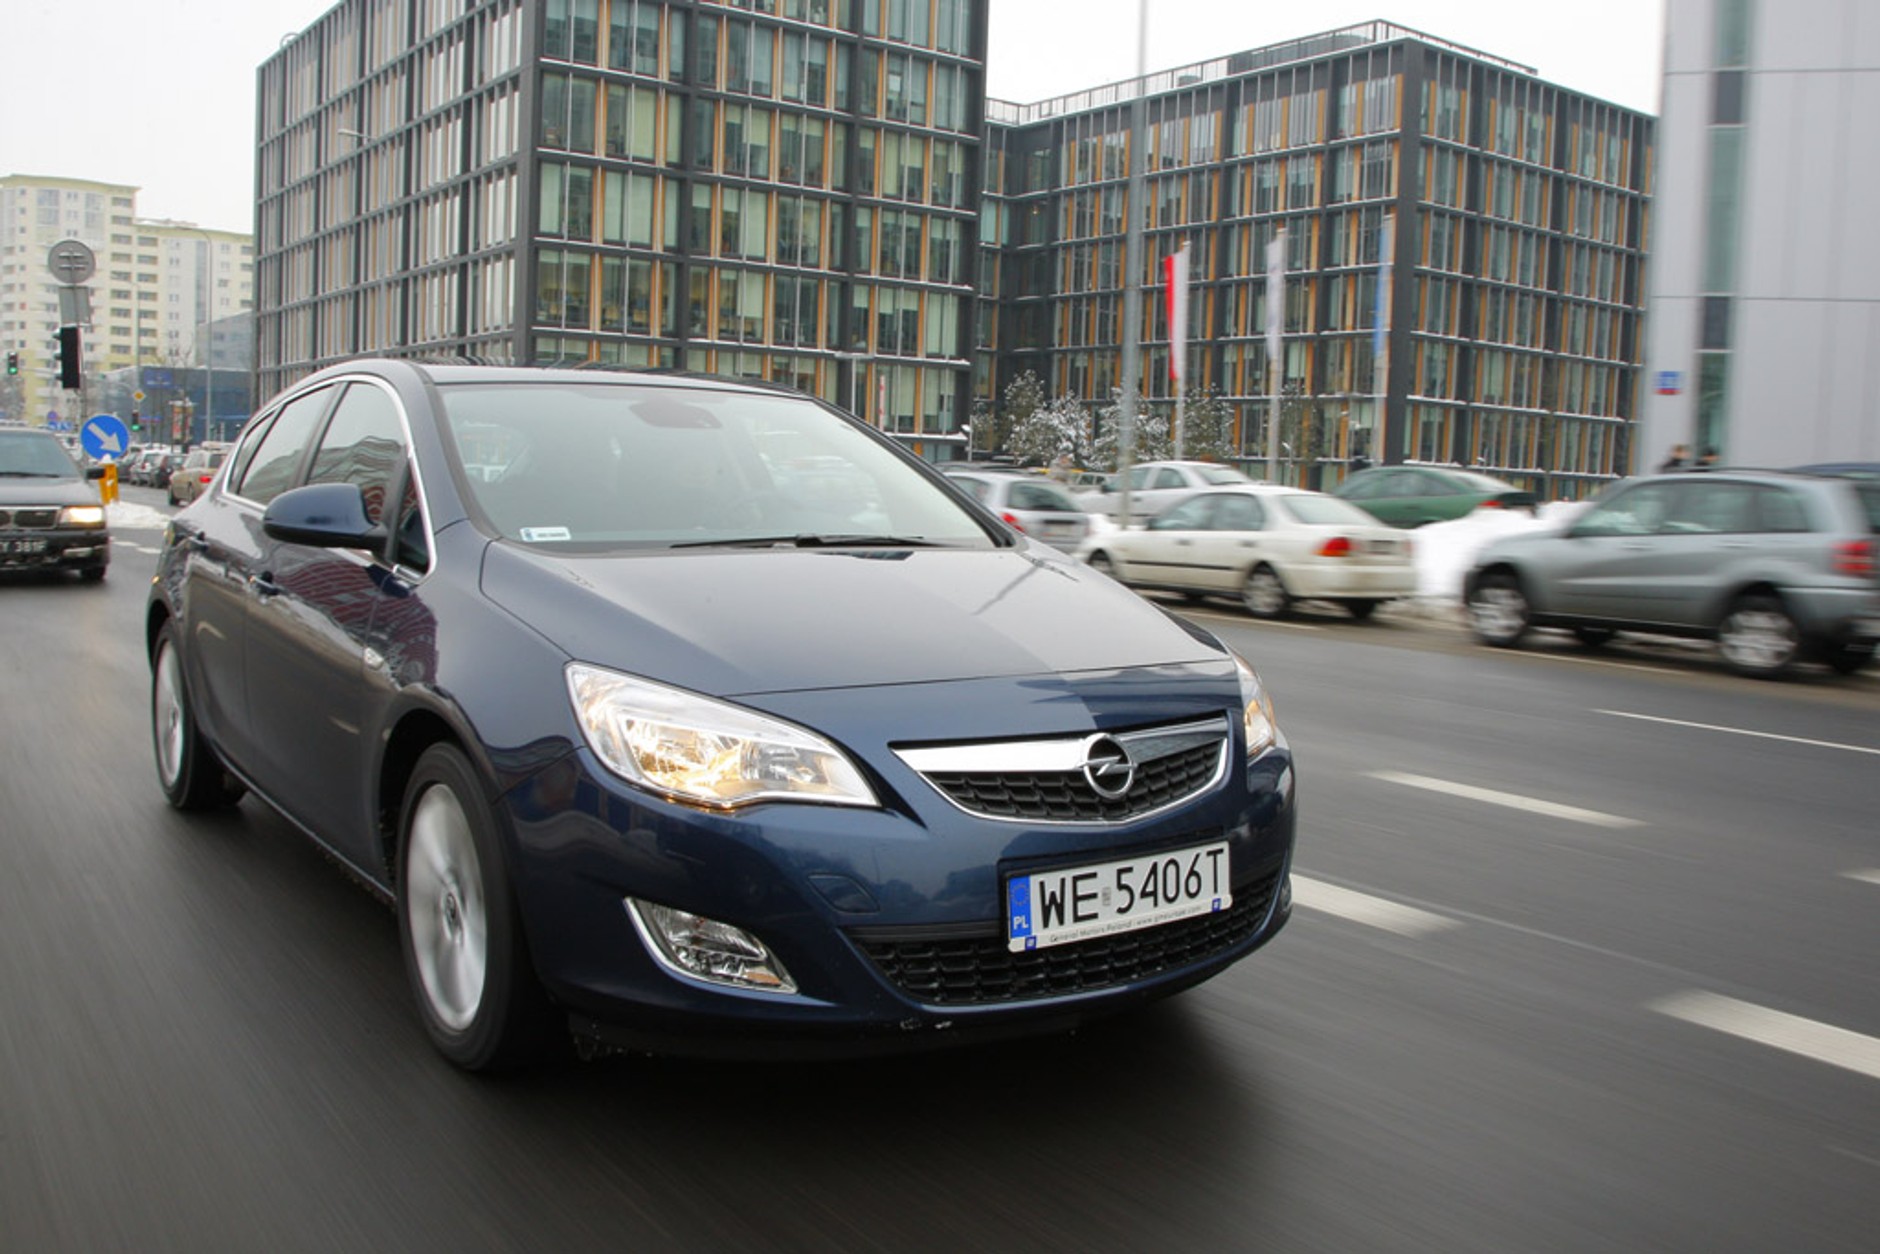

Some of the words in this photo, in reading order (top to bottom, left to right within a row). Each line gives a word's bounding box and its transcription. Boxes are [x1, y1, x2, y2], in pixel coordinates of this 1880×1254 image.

[1039, 871, 1099, 929] WE
[1116, 848, 1224, 914] 5406T
[1013, 915, 1029, 930] PL
